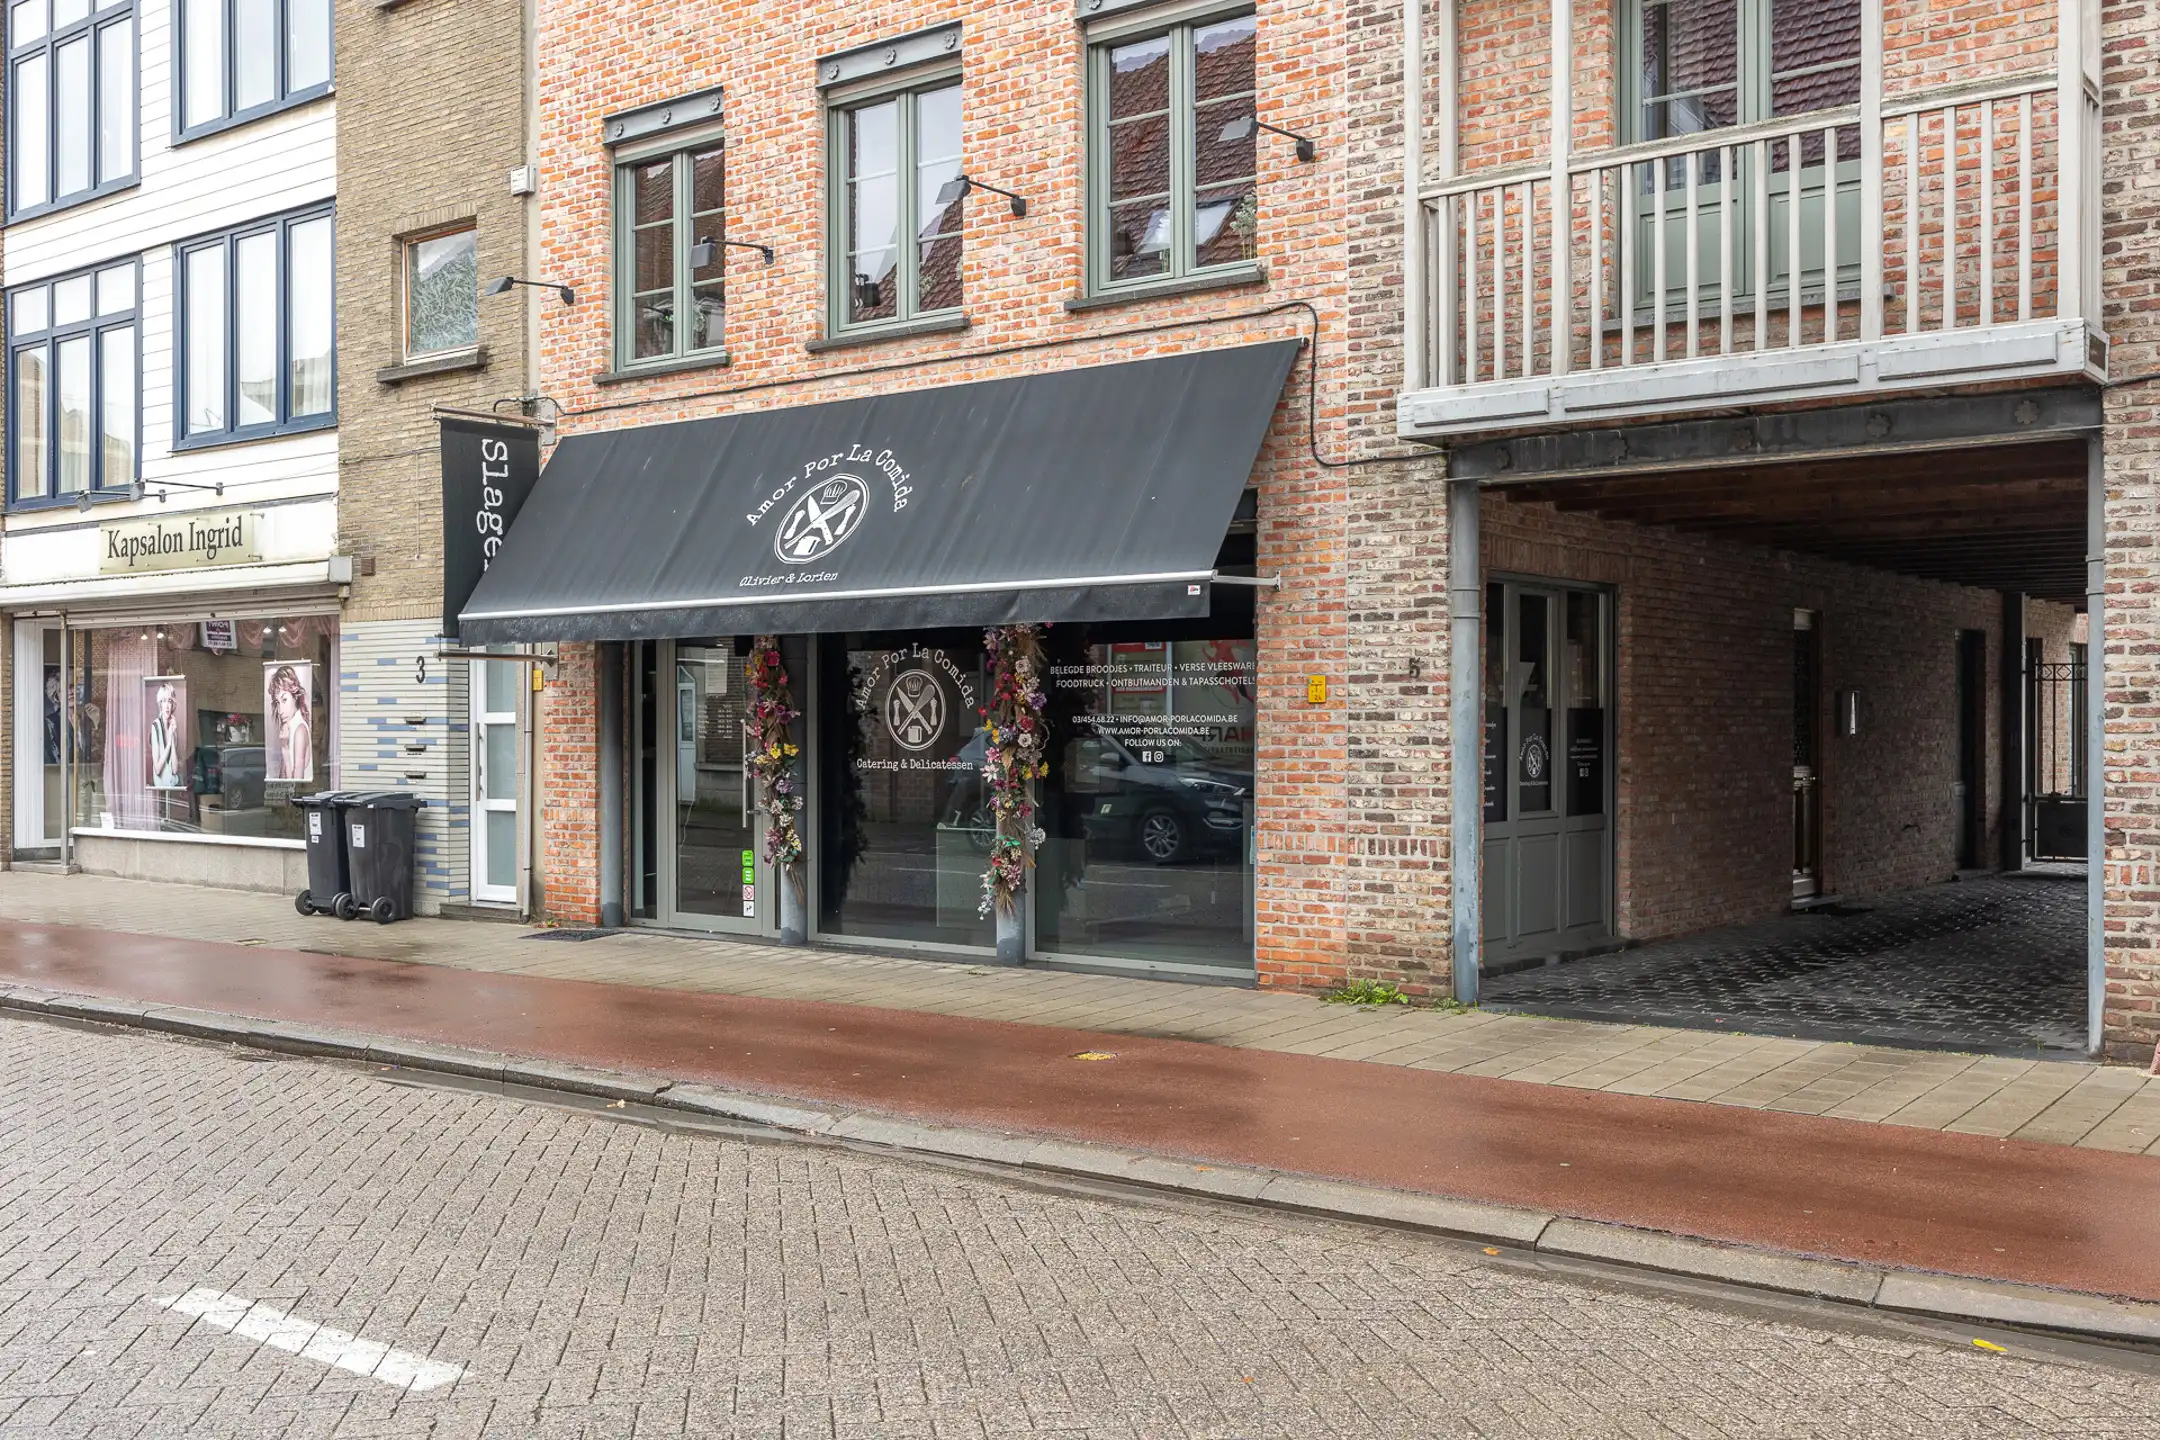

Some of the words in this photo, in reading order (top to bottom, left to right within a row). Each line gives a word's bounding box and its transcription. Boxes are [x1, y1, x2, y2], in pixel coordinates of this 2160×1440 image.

[745, 476, 797, 526] Amor
[804, 452, 844, 479] Por
[846, 443, 873, 462] La
[875, 449, 913, 513] Comida
[476, 438, 509, 572] Slage
[107, 529, 184, 567] Kapsalon
[189, 514, 244, 560] Ingrid
[739, 573, 784, 587] Olivier
[785, 573, 796, 584] &
[796, 570, 839, 583] Lorien
[416, 655, 426, 684] 3
[855, 667, 881, 710] Amor
[881, 647, 907, 670] Por
[912, 642, 930, 659] La
[934, 649, 975, 709] Comida
[1050, 665, 1084, 675] BELEGDE
[1086, 664, 1128, 674] BROODJES
[1134, 663, 1173, 672] TRAITEUR
[1179, 662, 1206, 672] VERSE
[1409, 657, 1421, 678] 5
[1055, 678, 1105, 688] FOODTRUCK
[1181, 677, 1188, 686] &
[1124, 738, 1155, 747] FOLLOW
[1156, 738, 1166, 747] US
[1167, 738, 1182, 747] ON:
[856, 758, 899, 771] Catering
[900, 759, 908, 770] &
[910, 758, 974, 772] Delicatessen
